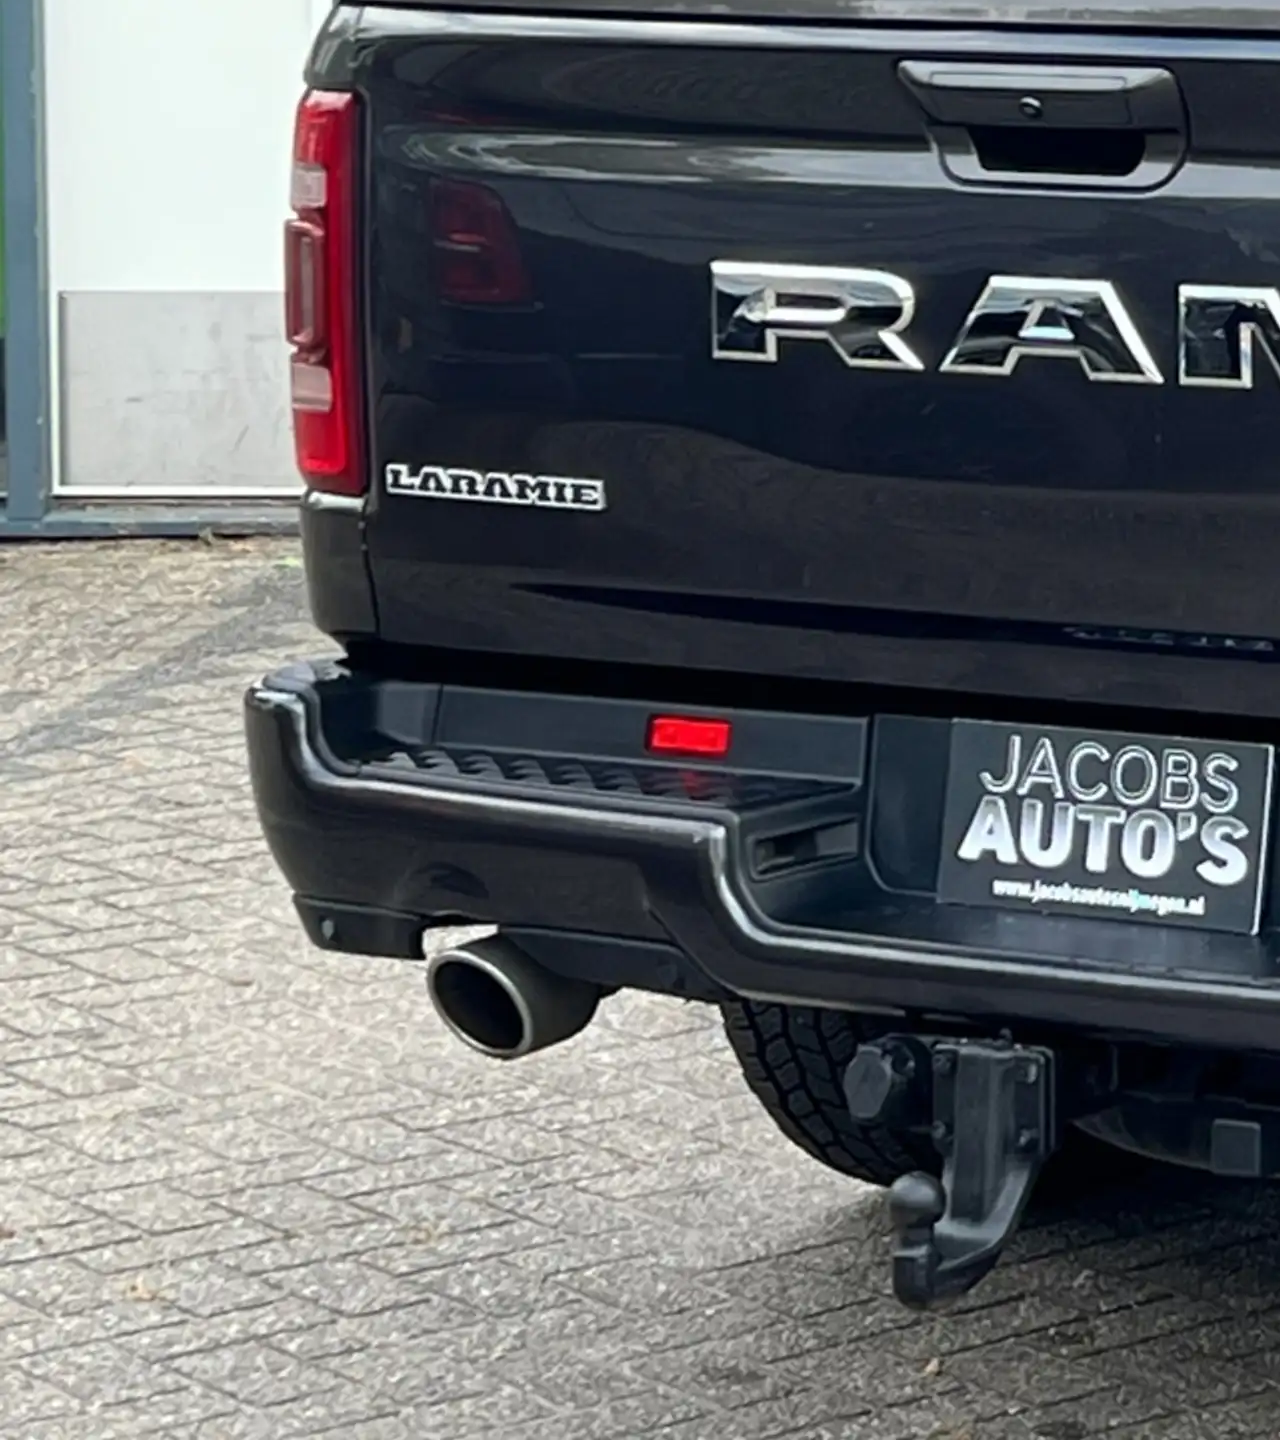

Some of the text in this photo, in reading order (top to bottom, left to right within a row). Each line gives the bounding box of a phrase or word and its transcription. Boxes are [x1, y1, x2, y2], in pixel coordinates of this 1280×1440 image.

[386, 464, 606, 510] LARAMIE
[980, 735, 1239, 813] JACOBS
[958, 796, 1250, 885] AUTO'S
